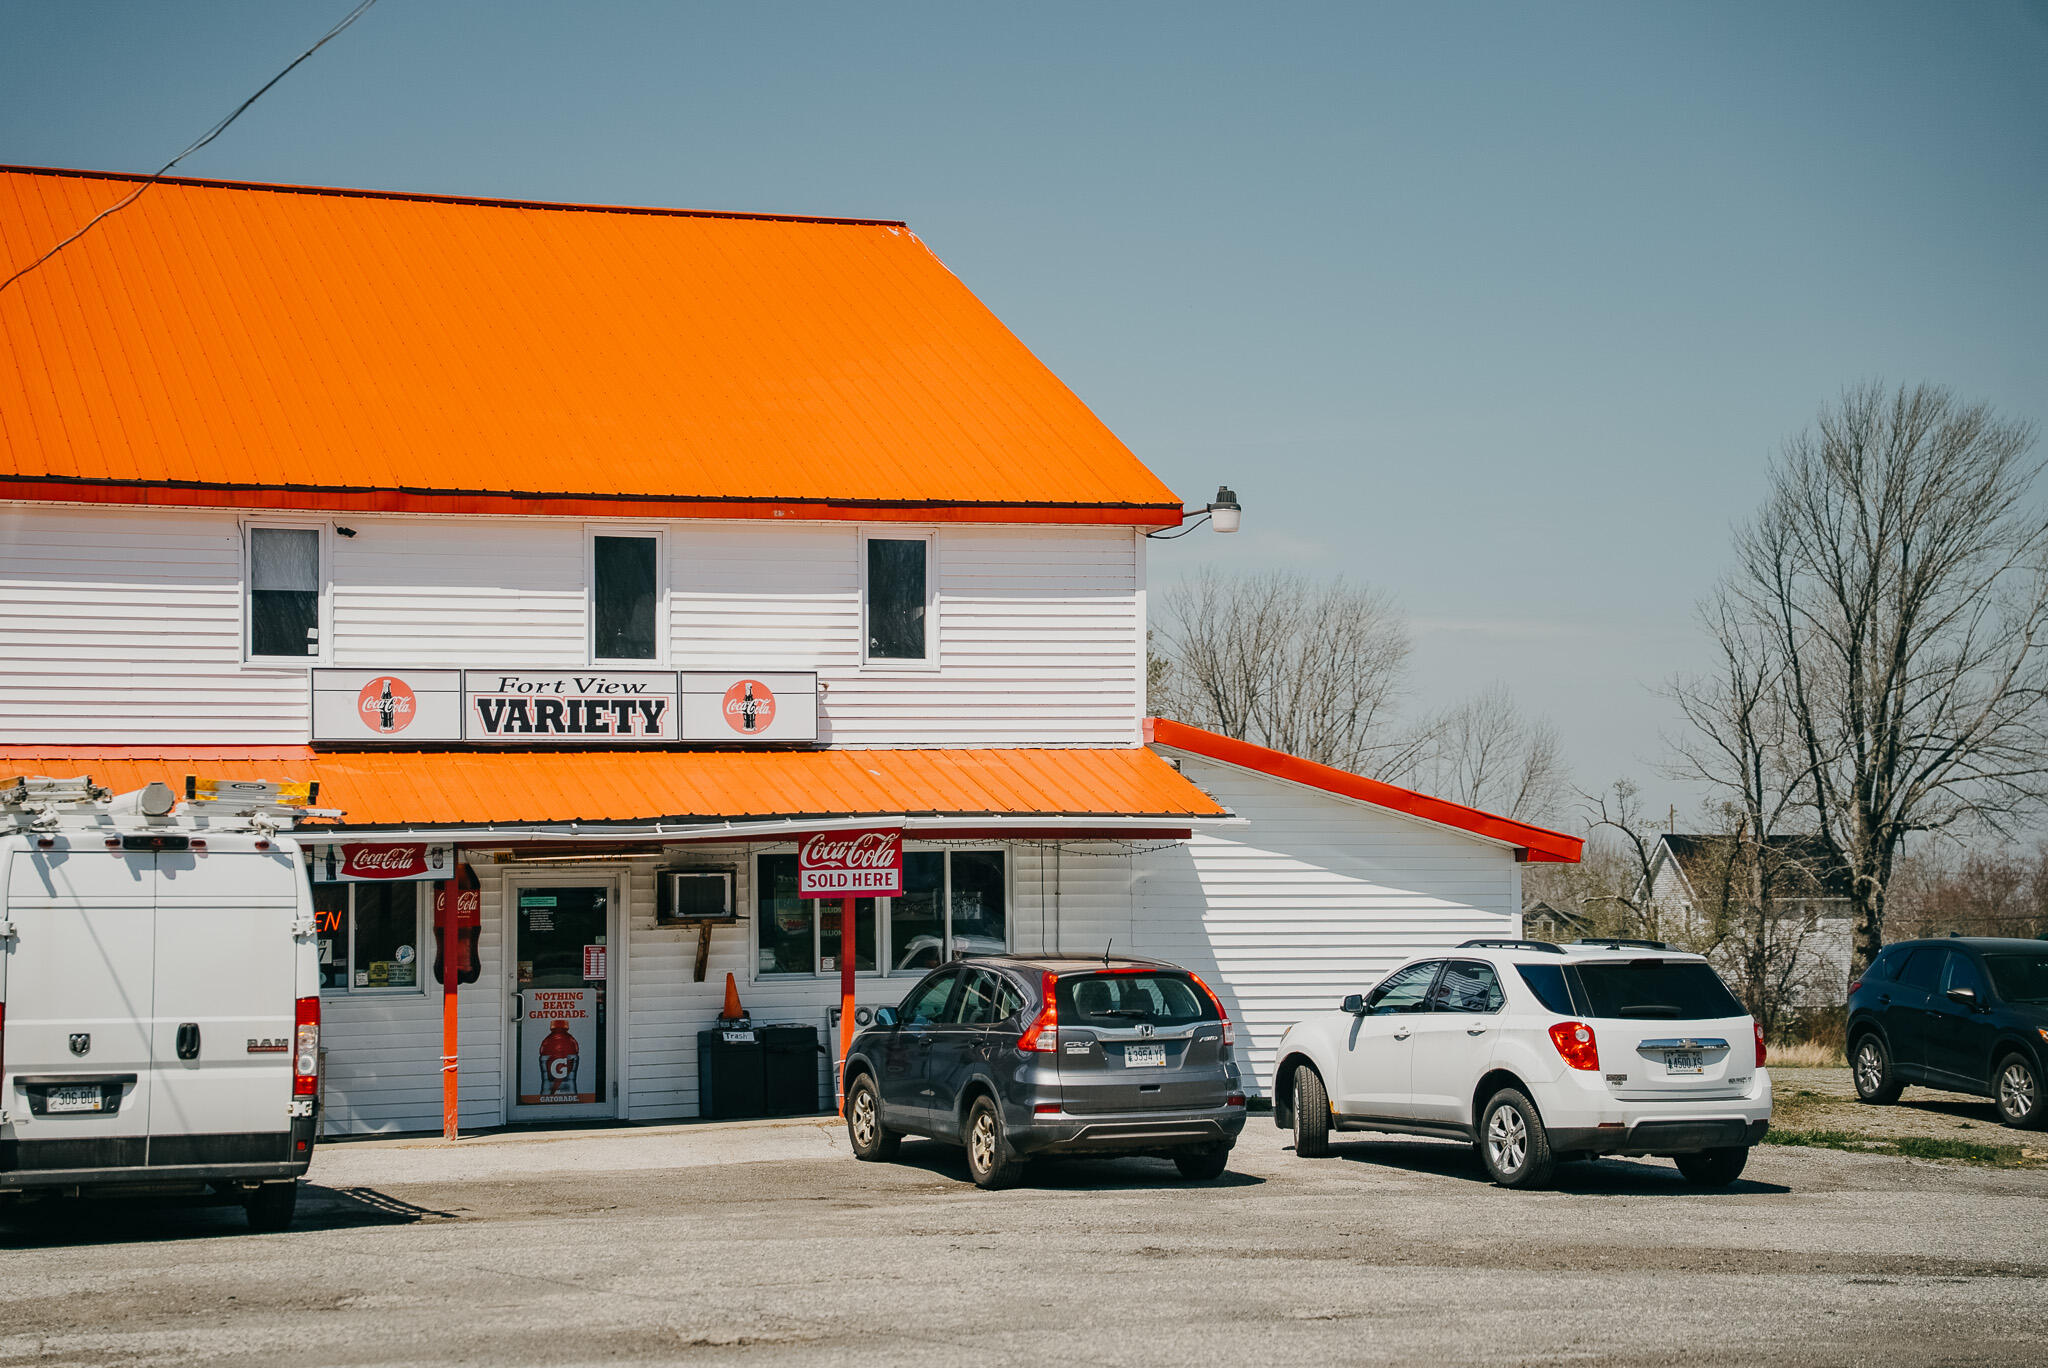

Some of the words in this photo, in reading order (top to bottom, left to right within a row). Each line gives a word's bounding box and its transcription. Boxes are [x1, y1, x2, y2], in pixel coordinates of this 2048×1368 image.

[498, 677, 566, 694] Fort
[574, 677, 648, 694] View
[476, 697, 667, 734] VARIETY
[807, 873, 847, 888] SOLD
[852, 872, 893, 887] HERE
[314, 910, 342, 932] EN
[534, 991, 584, 1001] NOTHING
[543, 1001, 575, 1009] BEATS
[529, 1010, 589, 1019] GATORADE.
[725, 1032, 748, 1040] Trash
[550, 1057, 568, 1079] G
